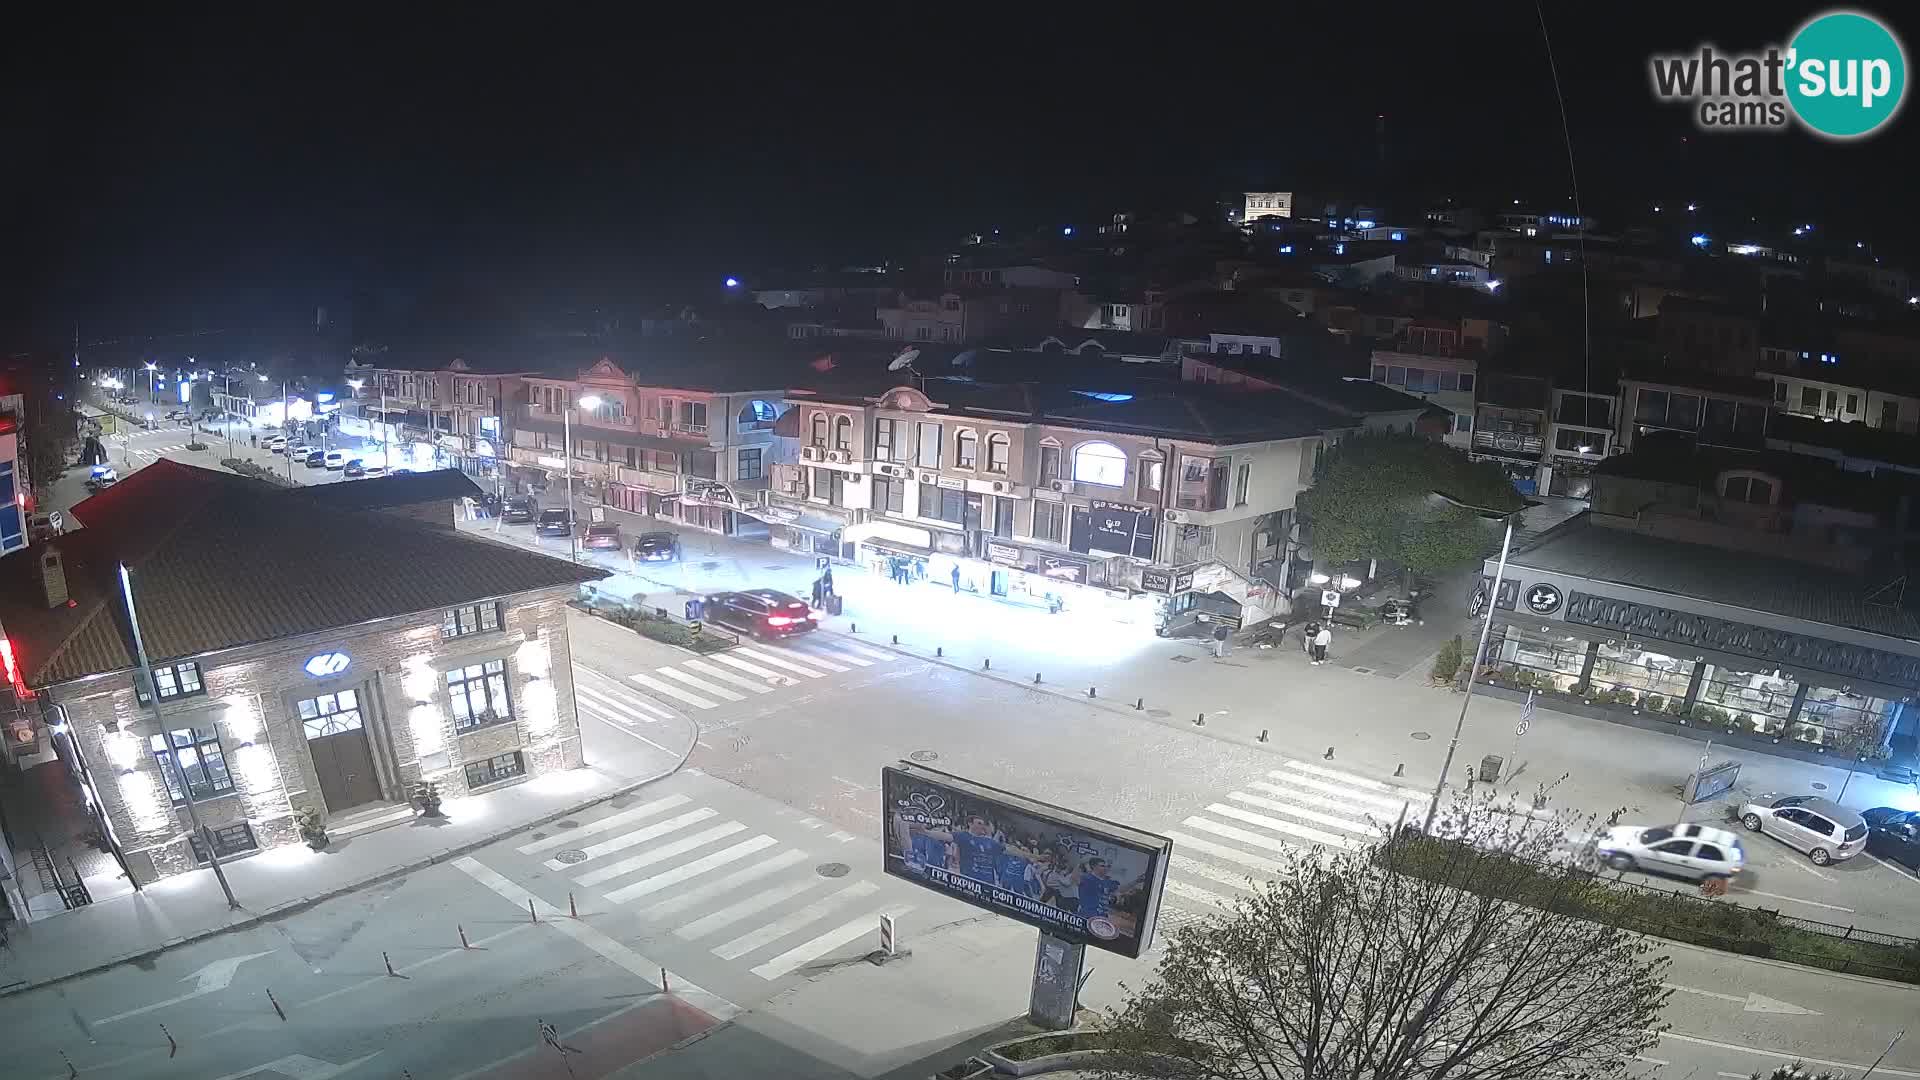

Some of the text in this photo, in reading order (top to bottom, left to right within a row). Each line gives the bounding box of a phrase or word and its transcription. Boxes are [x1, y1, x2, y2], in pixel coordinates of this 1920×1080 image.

[931, 868, 949, 882] ГРК
[951, 875, 982, 895] ОХРИД
[992, 889, 1013, 905] СФП
[1015, 896, 1084, 928] ОЛИМПИАКОС
